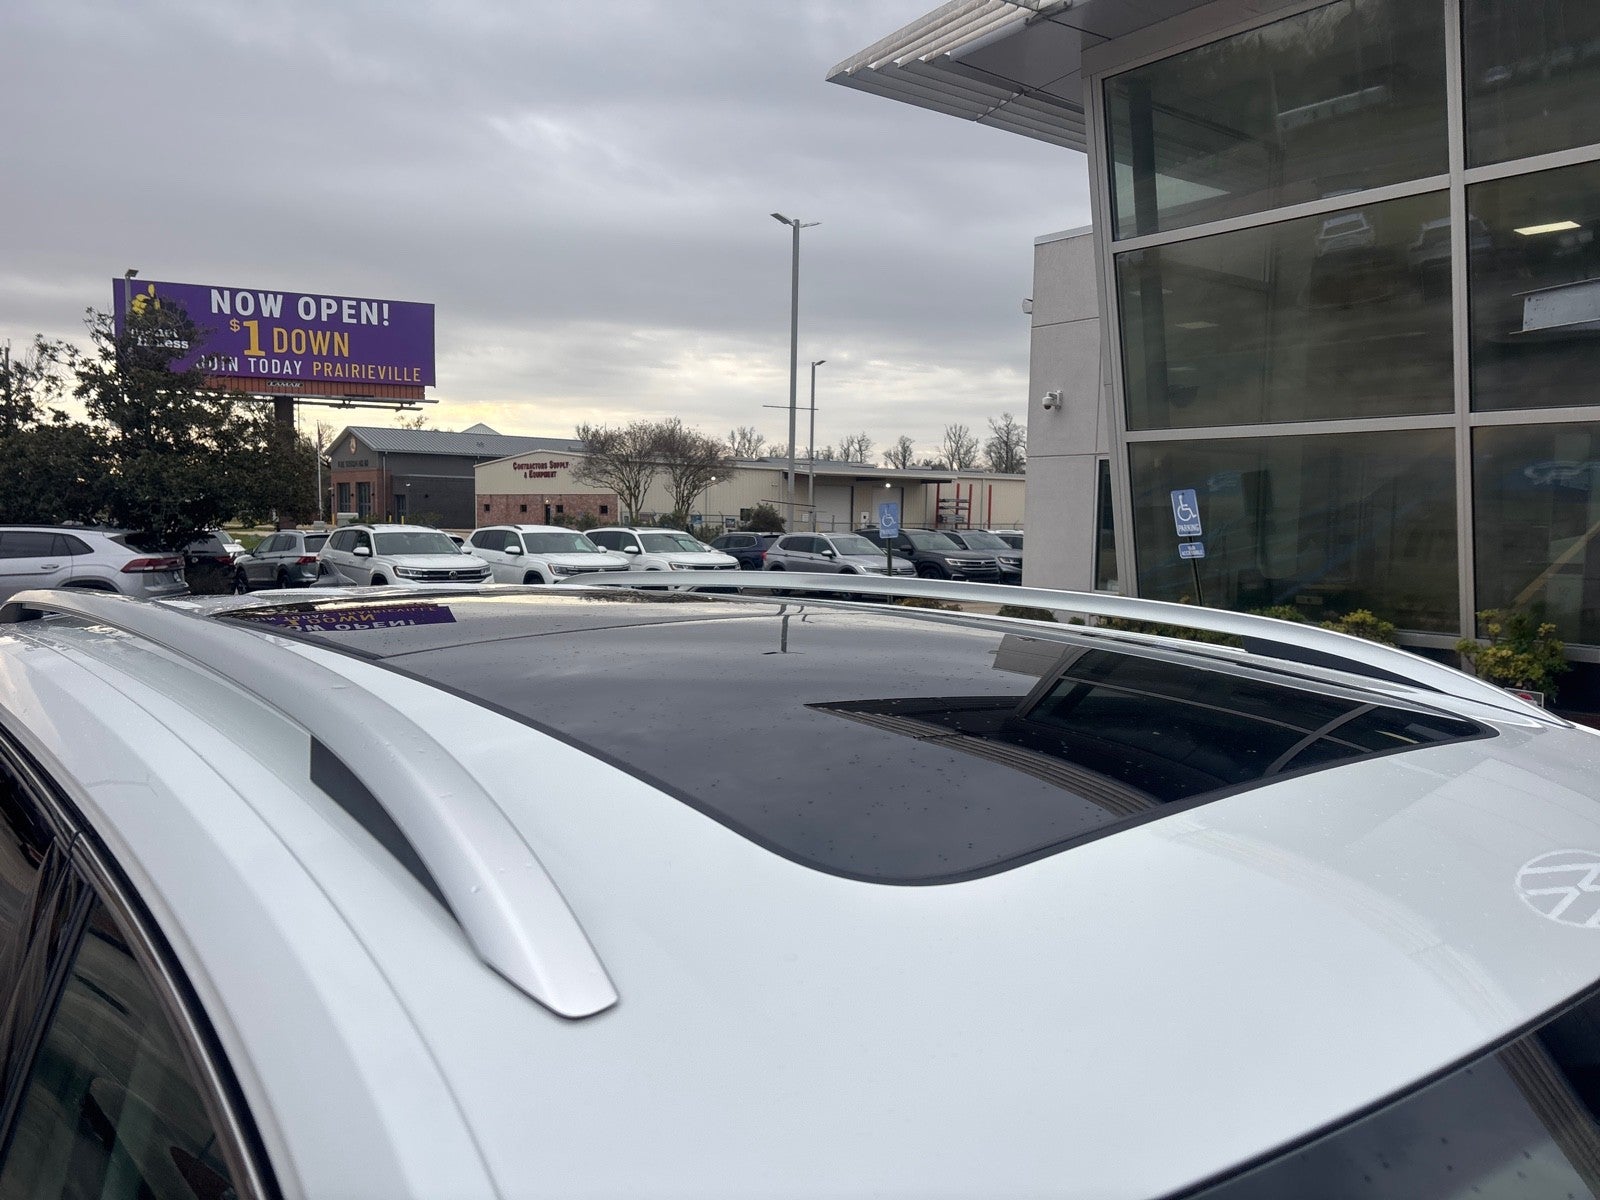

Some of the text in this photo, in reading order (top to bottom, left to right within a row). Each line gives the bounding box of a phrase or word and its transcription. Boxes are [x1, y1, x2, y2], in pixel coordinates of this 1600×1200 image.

[210, 288, 390, 327] NOW OPEN!
[229, 318, 349, 358] $1 DOWN
[247, 357, 302, 375] TODAY
[313, 361, 421, 382] PRAIRIEVILLE
